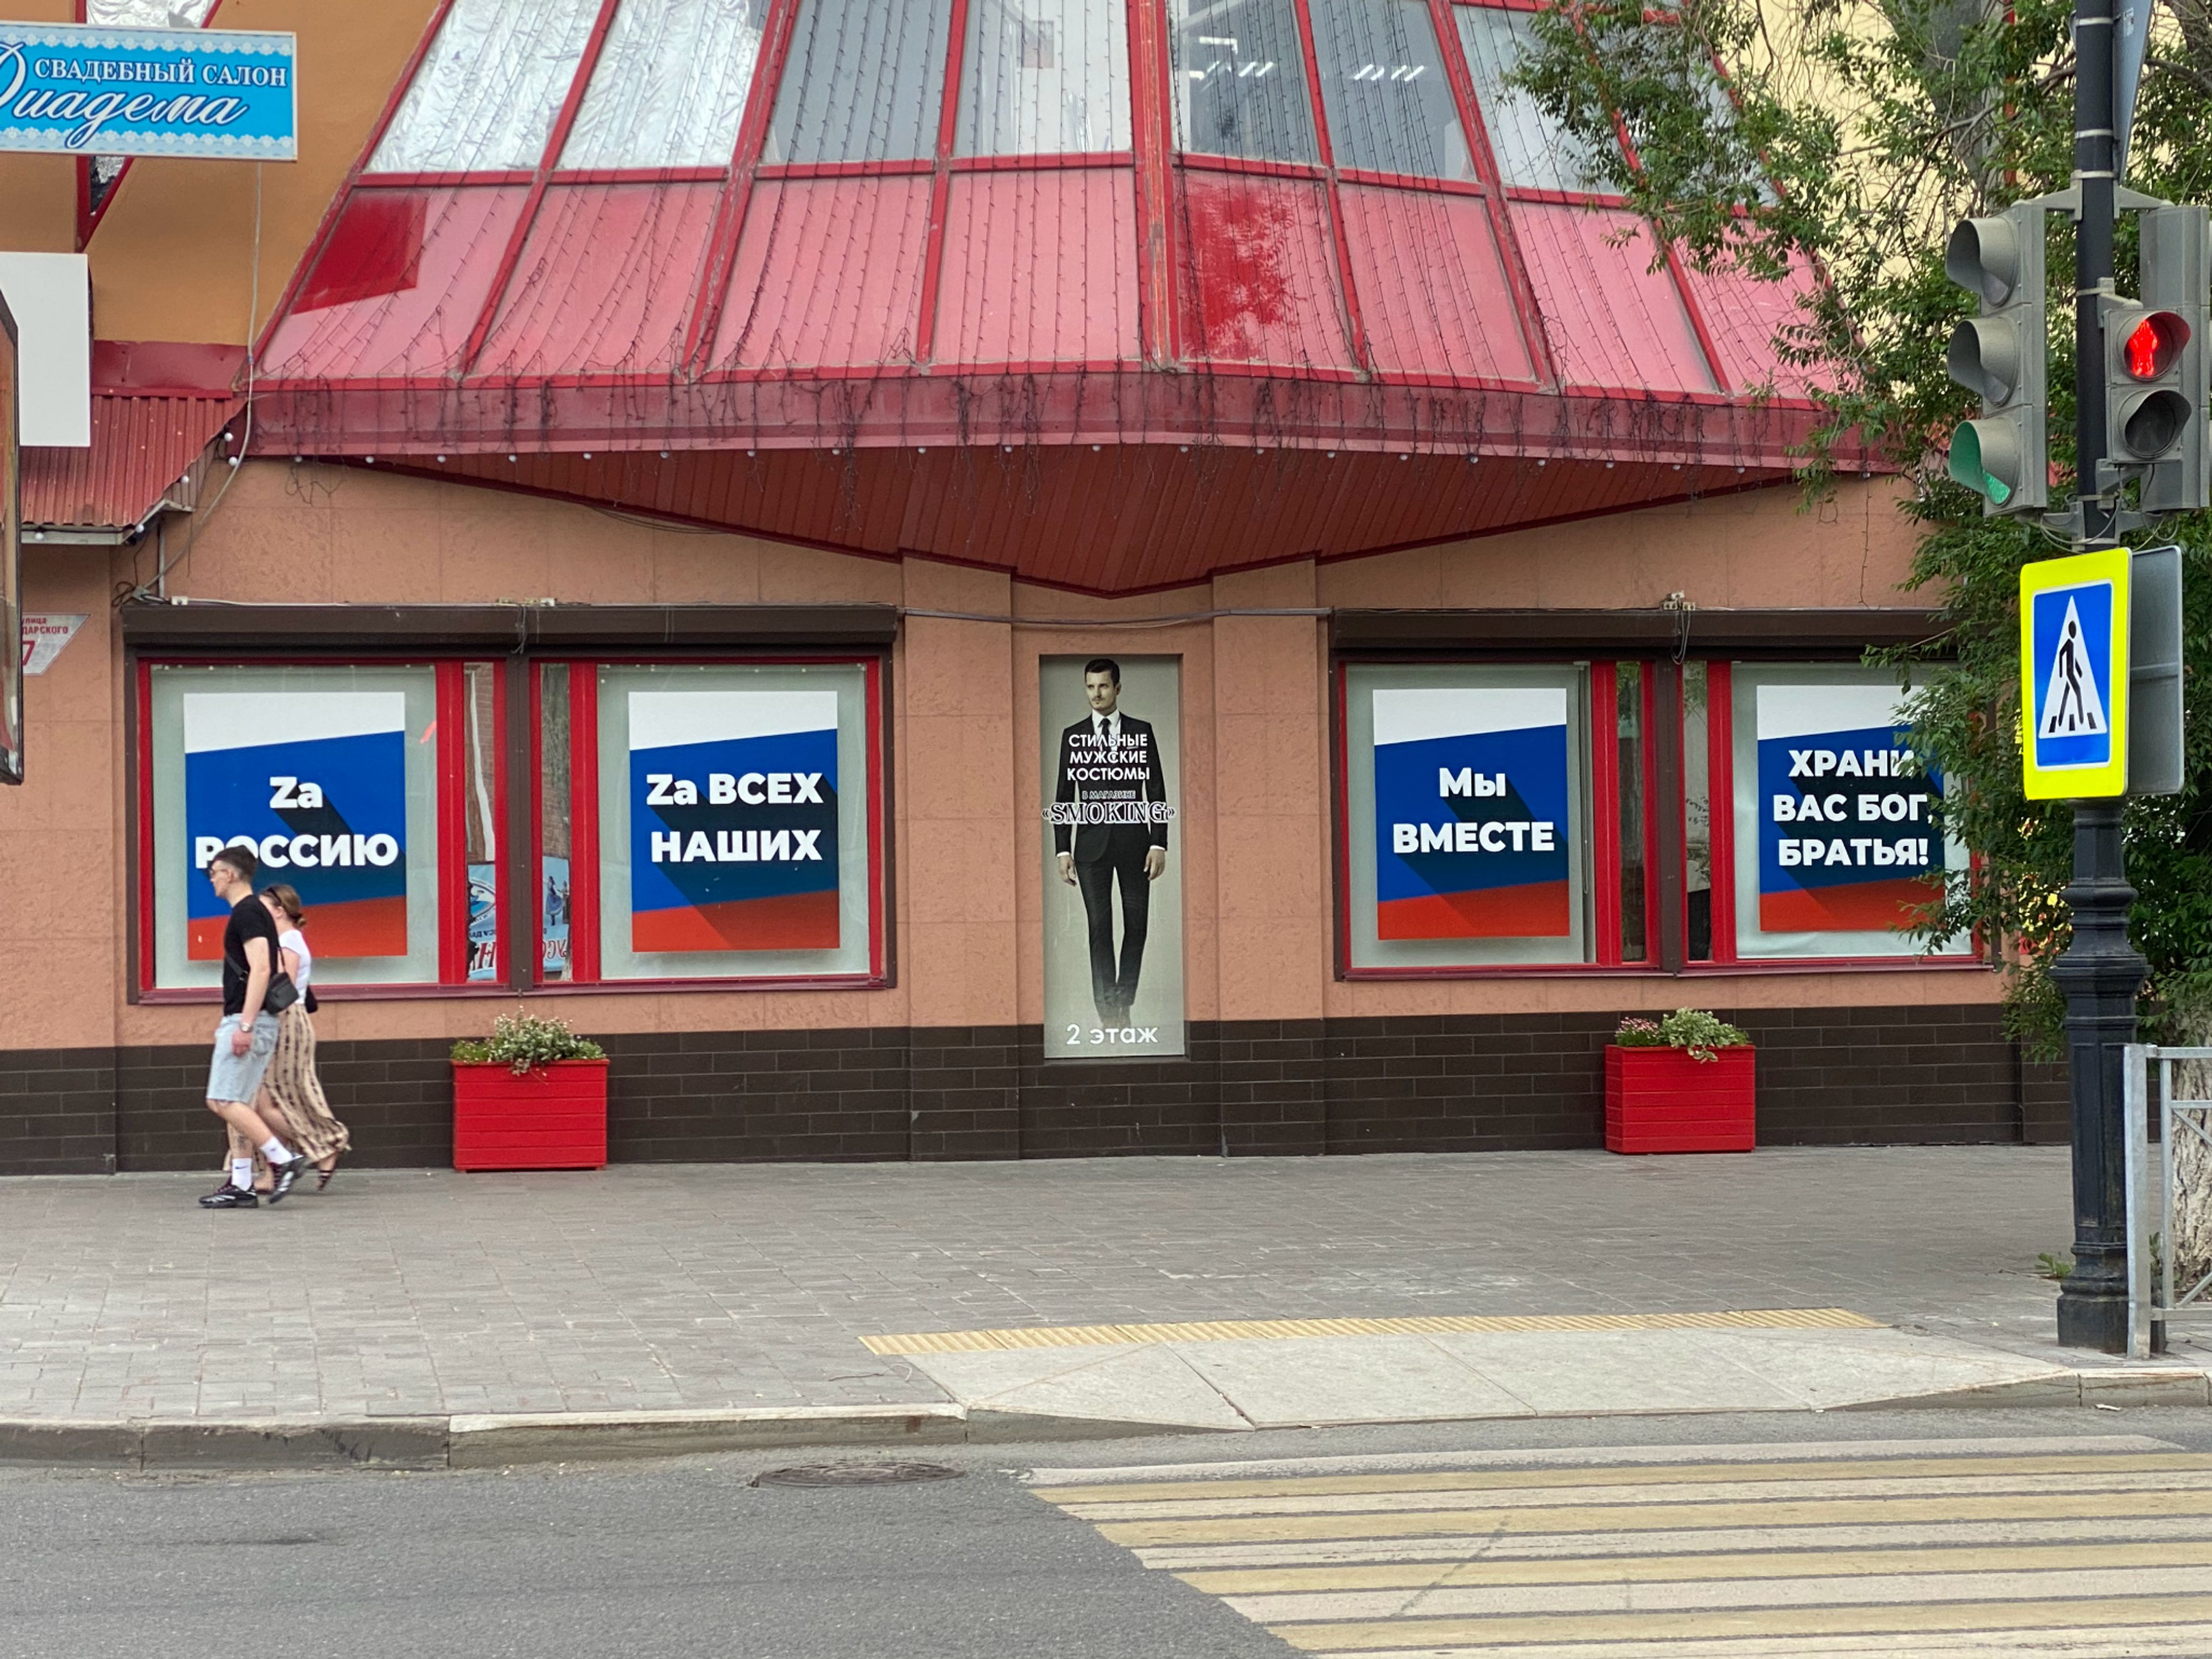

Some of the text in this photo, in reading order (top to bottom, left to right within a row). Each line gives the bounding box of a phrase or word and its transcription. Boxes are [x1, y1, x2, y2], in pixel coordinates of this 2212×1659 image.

[34, 58, 287, 87] СВАДЕБНЫЙ САЛОН
[23, 626, 69, 635] ДАРСКОГО
[1068, 734, 1148, 748] СТИЛЬНЫЕ
[1069, 750, 1147, 764] МУЖСКИЕ
[1788, 750, 1915, 778] ХРАНИ
[1067, 767, 1150, 781] КОСТЮМЫ
[1439, 767, 1506, 798] Мы
[269, 776, 323, 809] Za
[646, 772, 824, 806] Za ВСЕХ
[1082, 790, 1136, 799] В МАГАЗИНЕ
[1041, 801, 1176, 825] «SMOKING»
[1772, 793, 1933, 824] ВАС БОГ,
[651, 830, 823, 862] НАШИХ
[1393, 821, 1555, 853] ВМЕСТЕ
[1778, 838, 1929, 866] БРАТЬЯ!
[1066, 1024, 1159, 1045] 2 этаж
